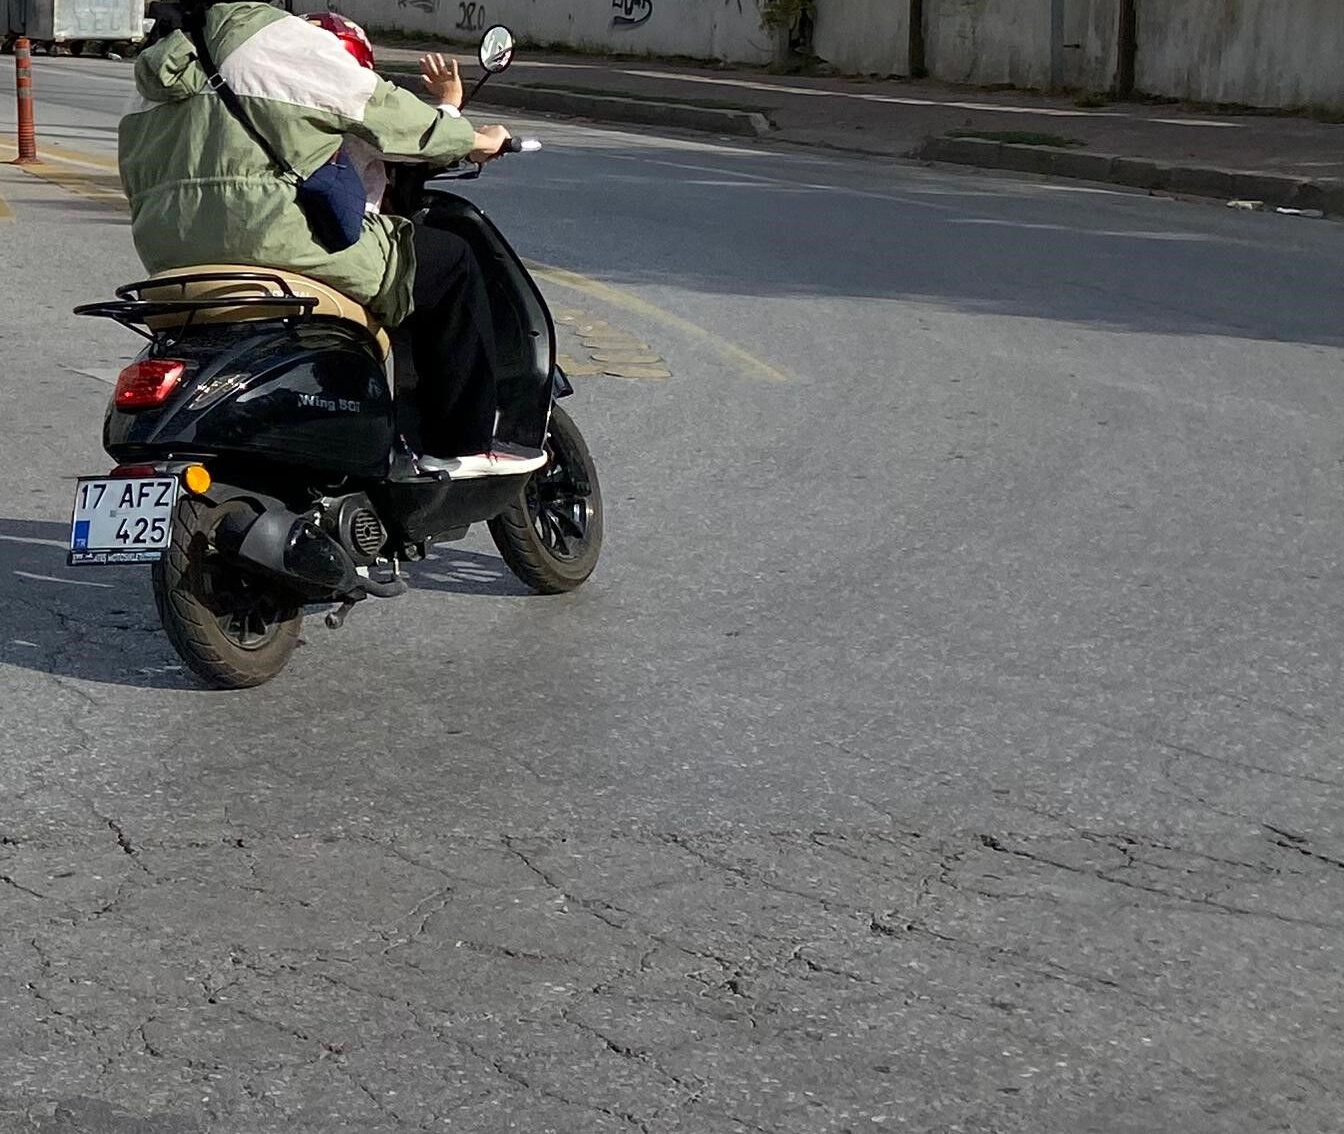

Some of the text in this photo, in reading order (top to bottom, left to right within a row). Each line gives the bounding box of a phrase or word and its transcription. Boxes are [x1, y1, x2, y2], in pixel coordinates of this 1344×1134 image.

[298, 394, 336, 412] Wing
[82, 481, 172, 509] 17 AFZ
[115, 517, 167, 544] 425
